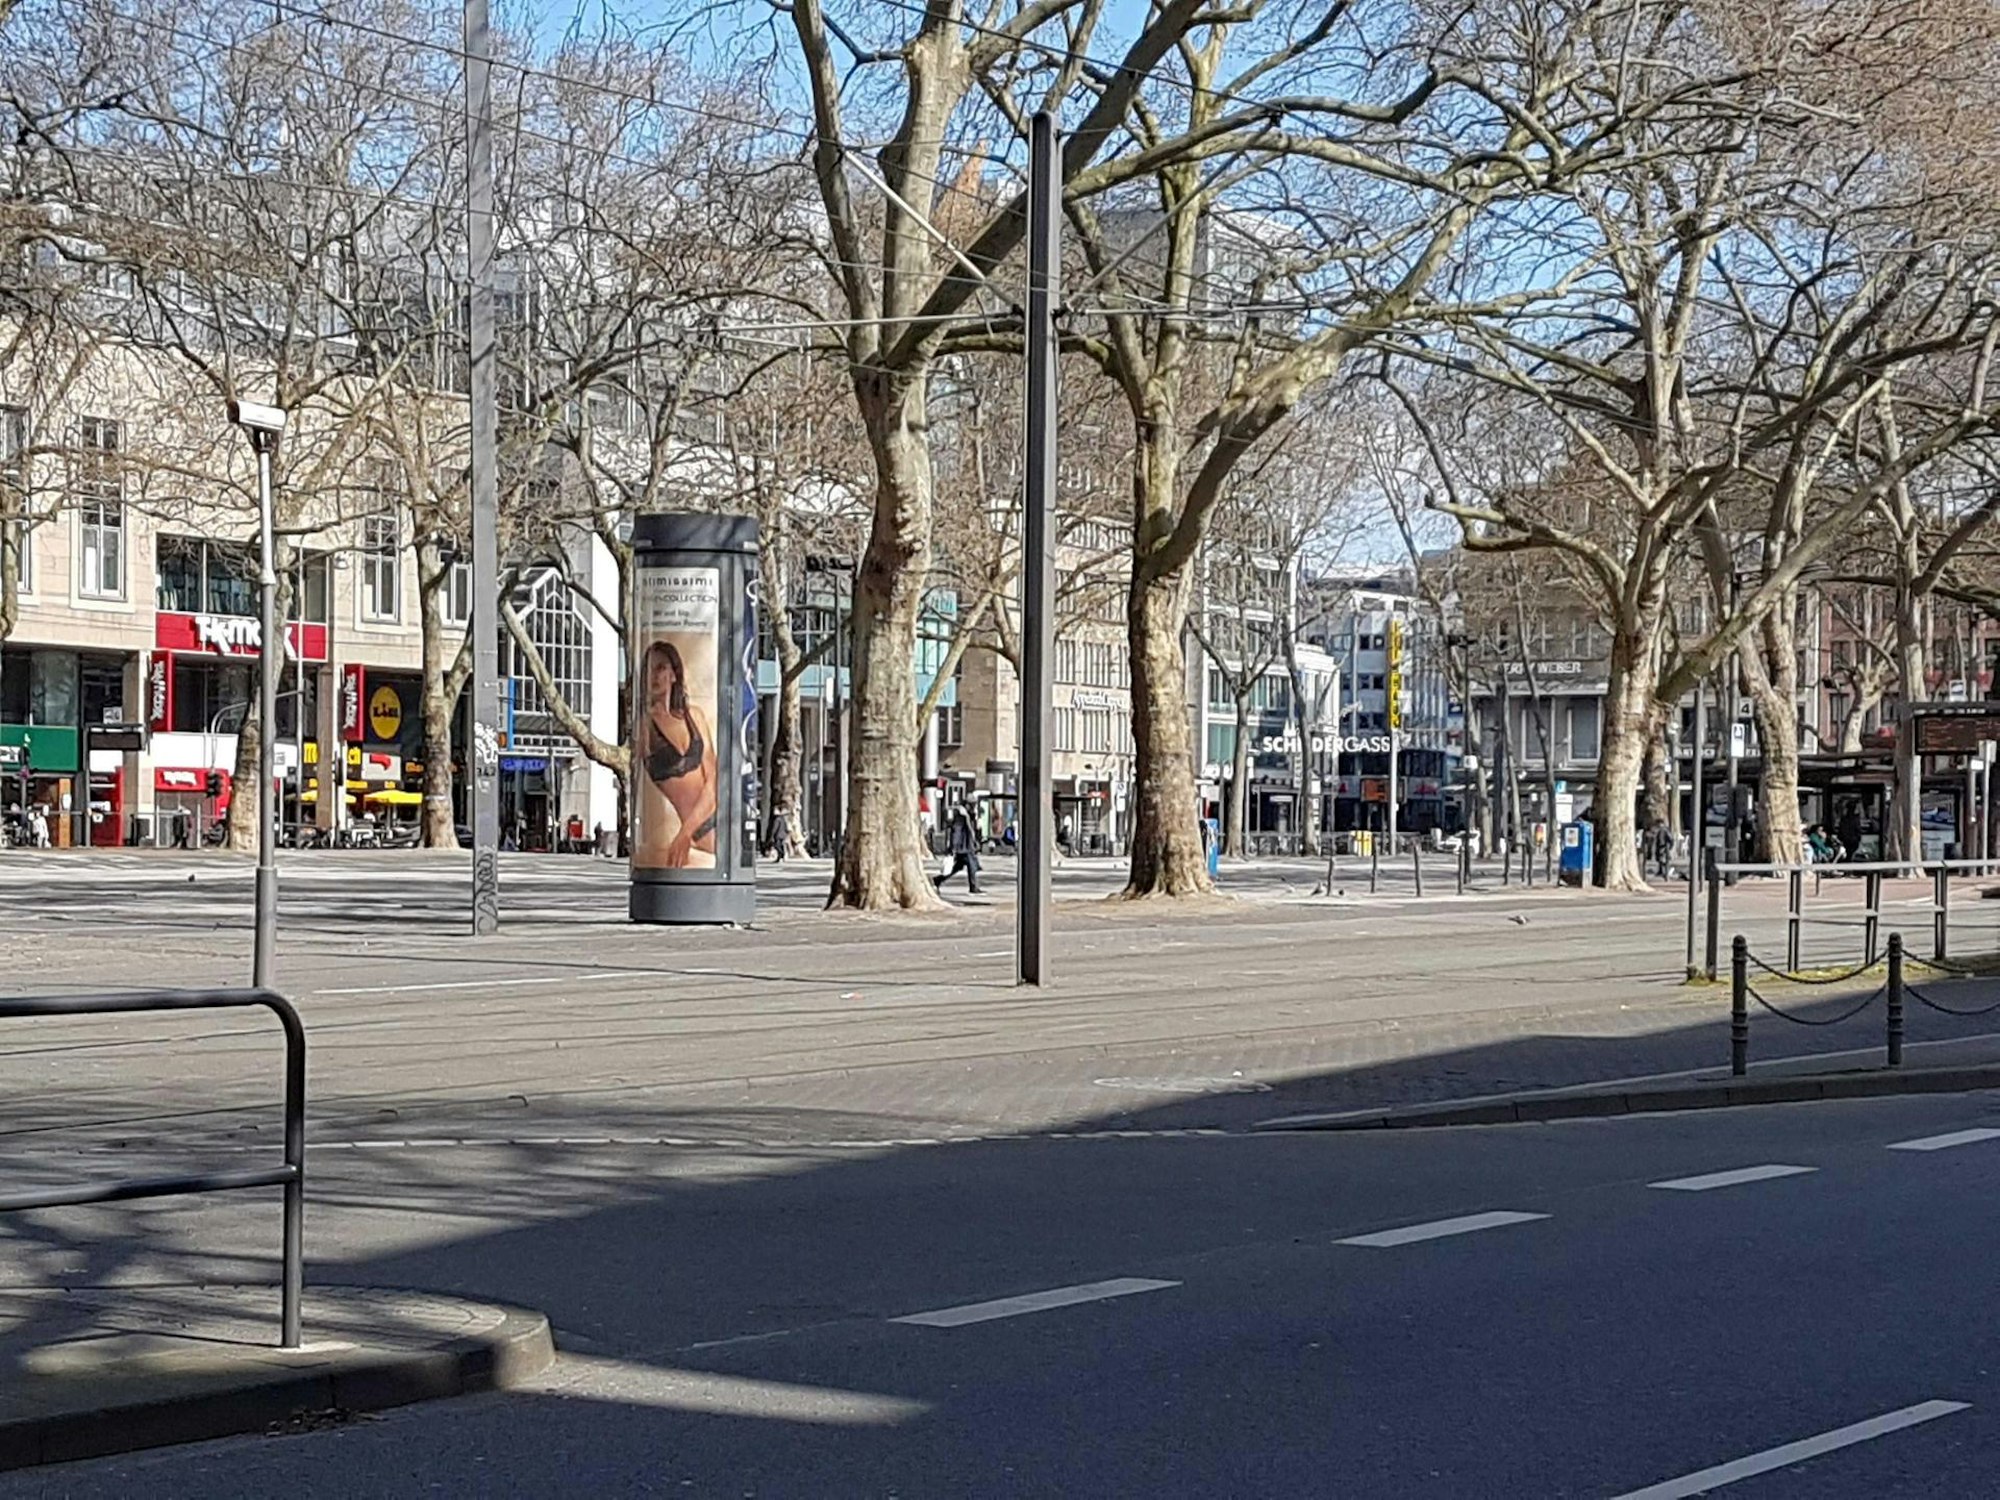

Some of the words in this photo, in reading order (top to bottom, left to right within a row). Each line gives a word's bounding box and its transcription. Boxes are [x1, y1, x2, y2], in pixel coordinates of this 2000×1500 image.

[1537, 661, 1582, 673] WEBER
[1741, 703, 1750, 714] 4
[1262, 736, 1391, 753] SCHIDERGASS
